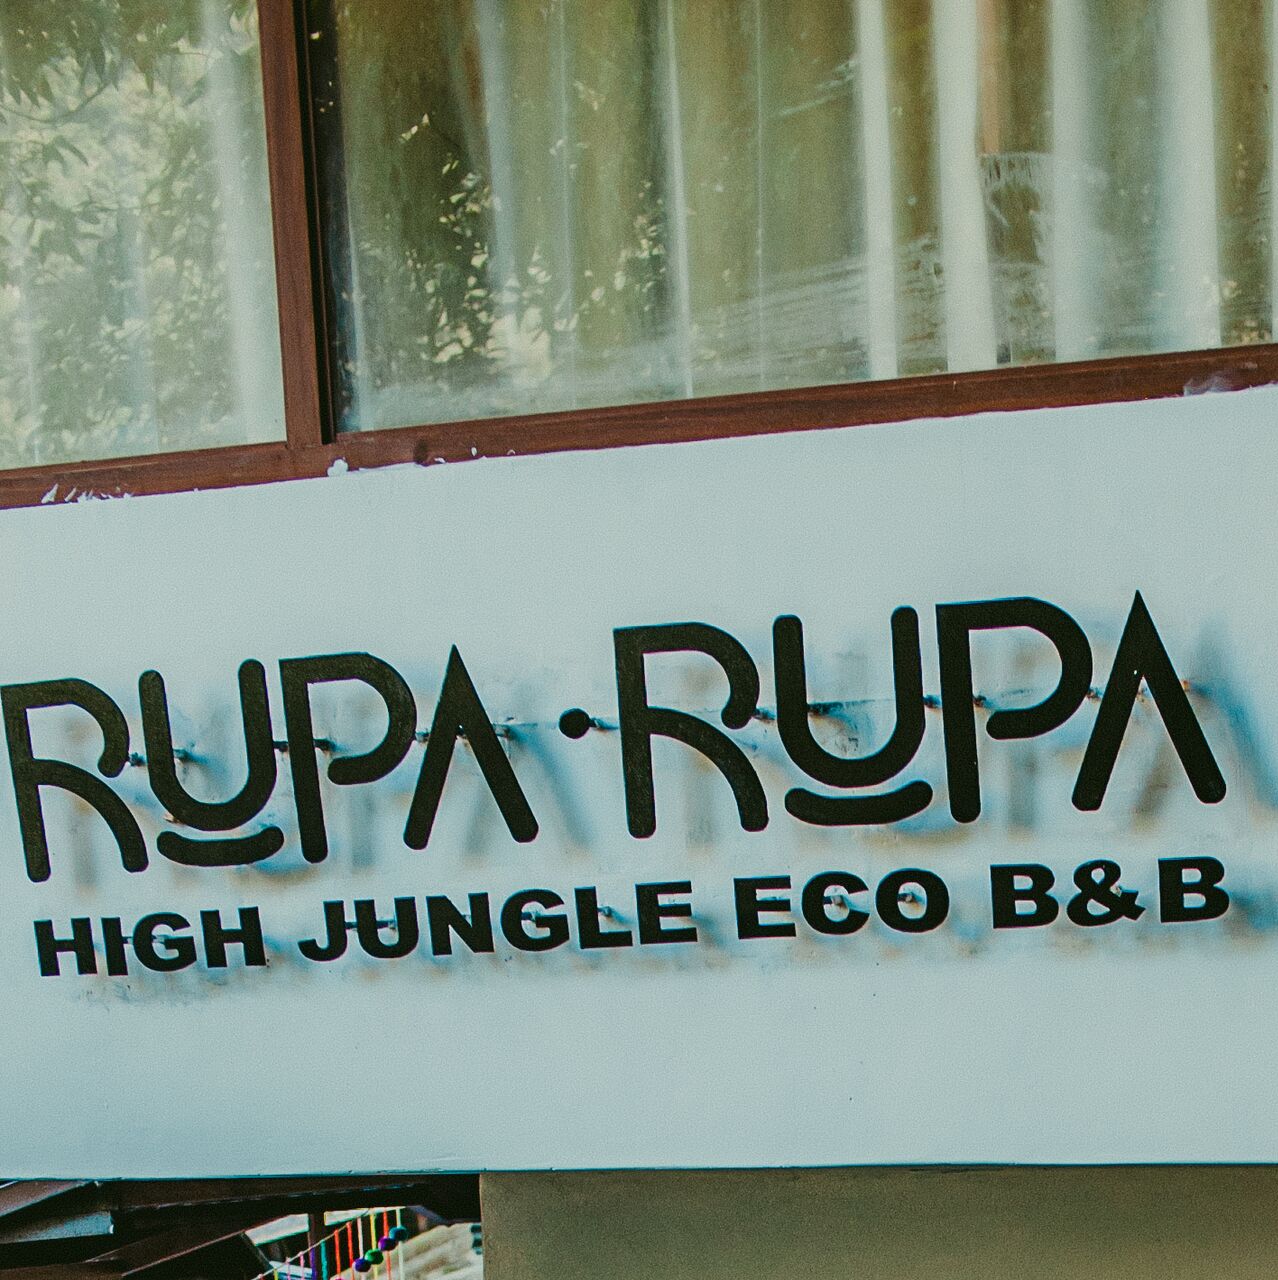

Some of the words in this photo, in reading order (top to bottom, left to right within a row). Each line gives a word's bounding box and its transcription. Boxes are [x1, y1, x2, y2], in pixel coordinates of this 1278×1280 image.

[0, 645, 539, 882] RUPA
[614, 590, 1227, 838] RUPA
[34, 907, 267, 977] HIGH
[298, 881, 698, 962] JUNGLE
[734, 869, 950, 939] ECO
[991, 857, 1230, 928] B&B
